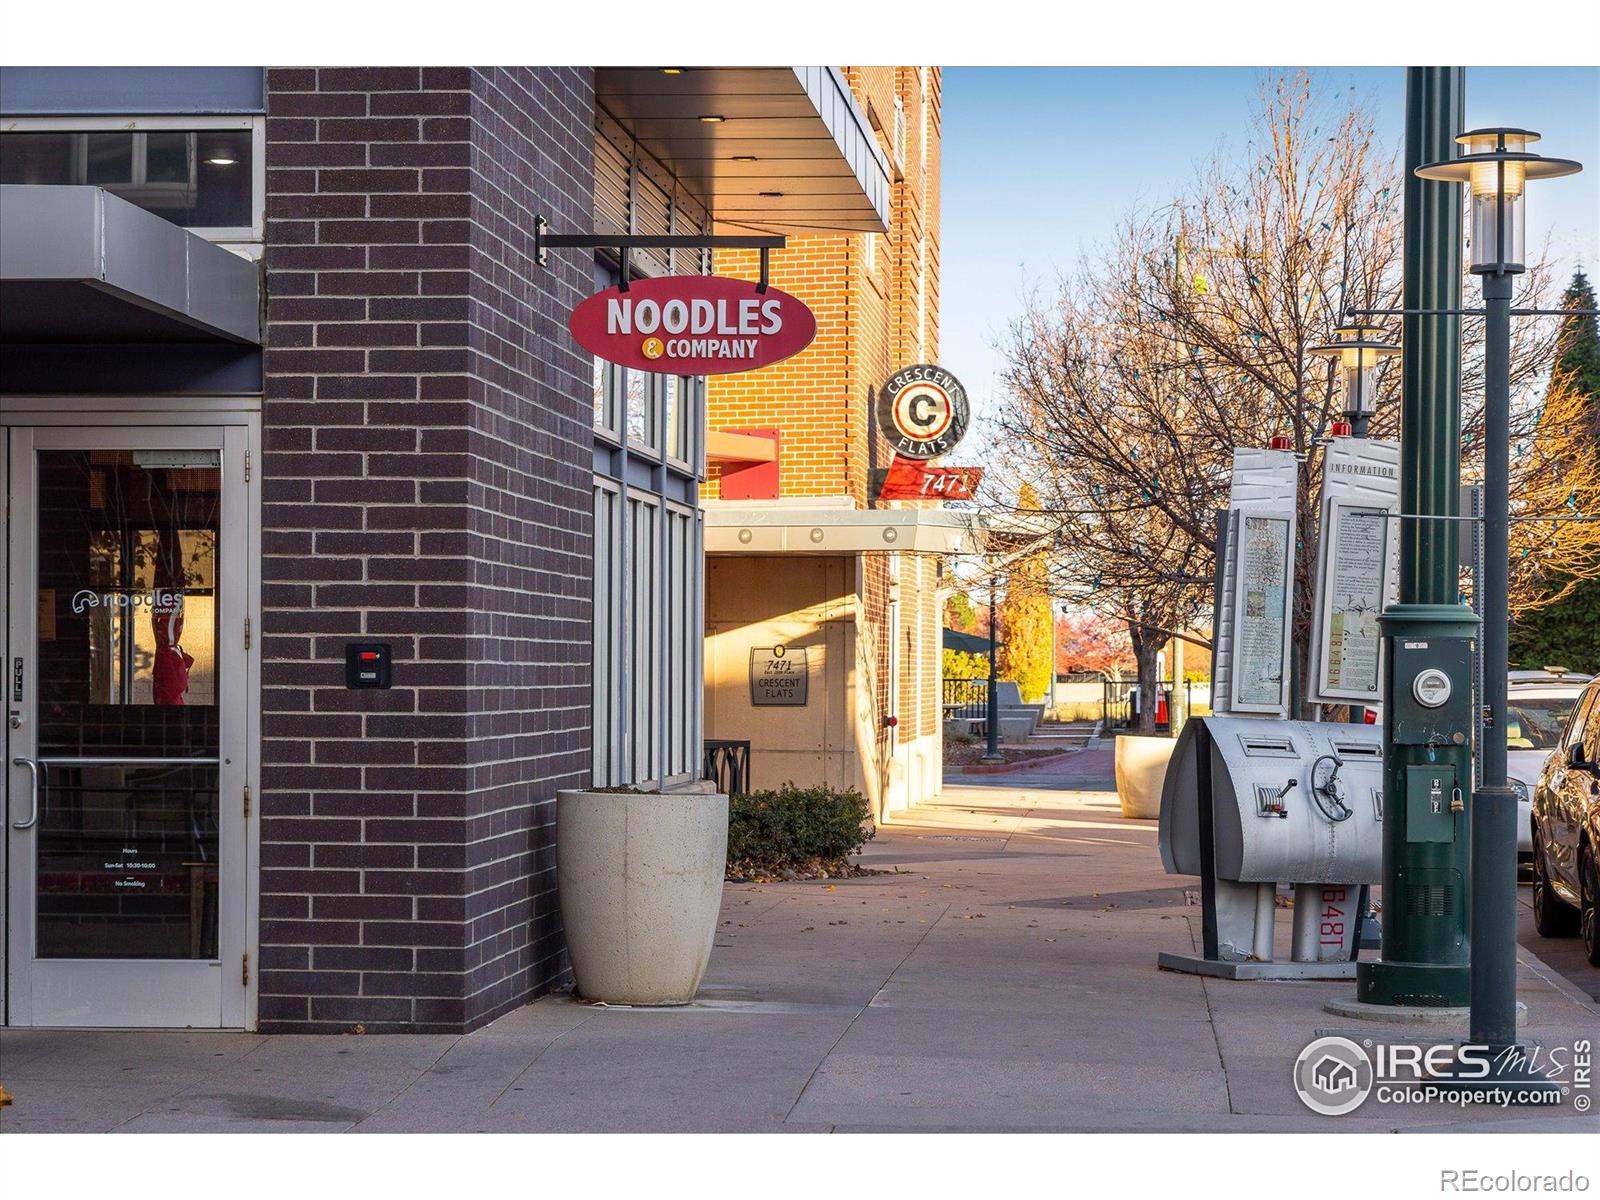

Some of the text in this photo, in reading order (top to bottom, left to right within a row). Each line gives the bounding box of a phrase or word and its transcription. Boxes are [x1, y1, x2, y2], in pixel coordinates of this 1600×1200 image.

[607, 298, 783, 335] NOODLES
[645, 339, 758, 359] & COMPANY
[888, 368, 960, 394] CRESCENT
[909, 394, 937, 427] C
[898, 437, 947, 454] FLATS
[1331, 463, 1394, 476] INFORMATION
[920, 474, 969, 495] 7471
[103, 589, 184, 607] noodles
[767, 660, 791, 671] 7471
[758, 678, 800, 688] CRESCENT
[765, 689, 794, 698] FLATS
